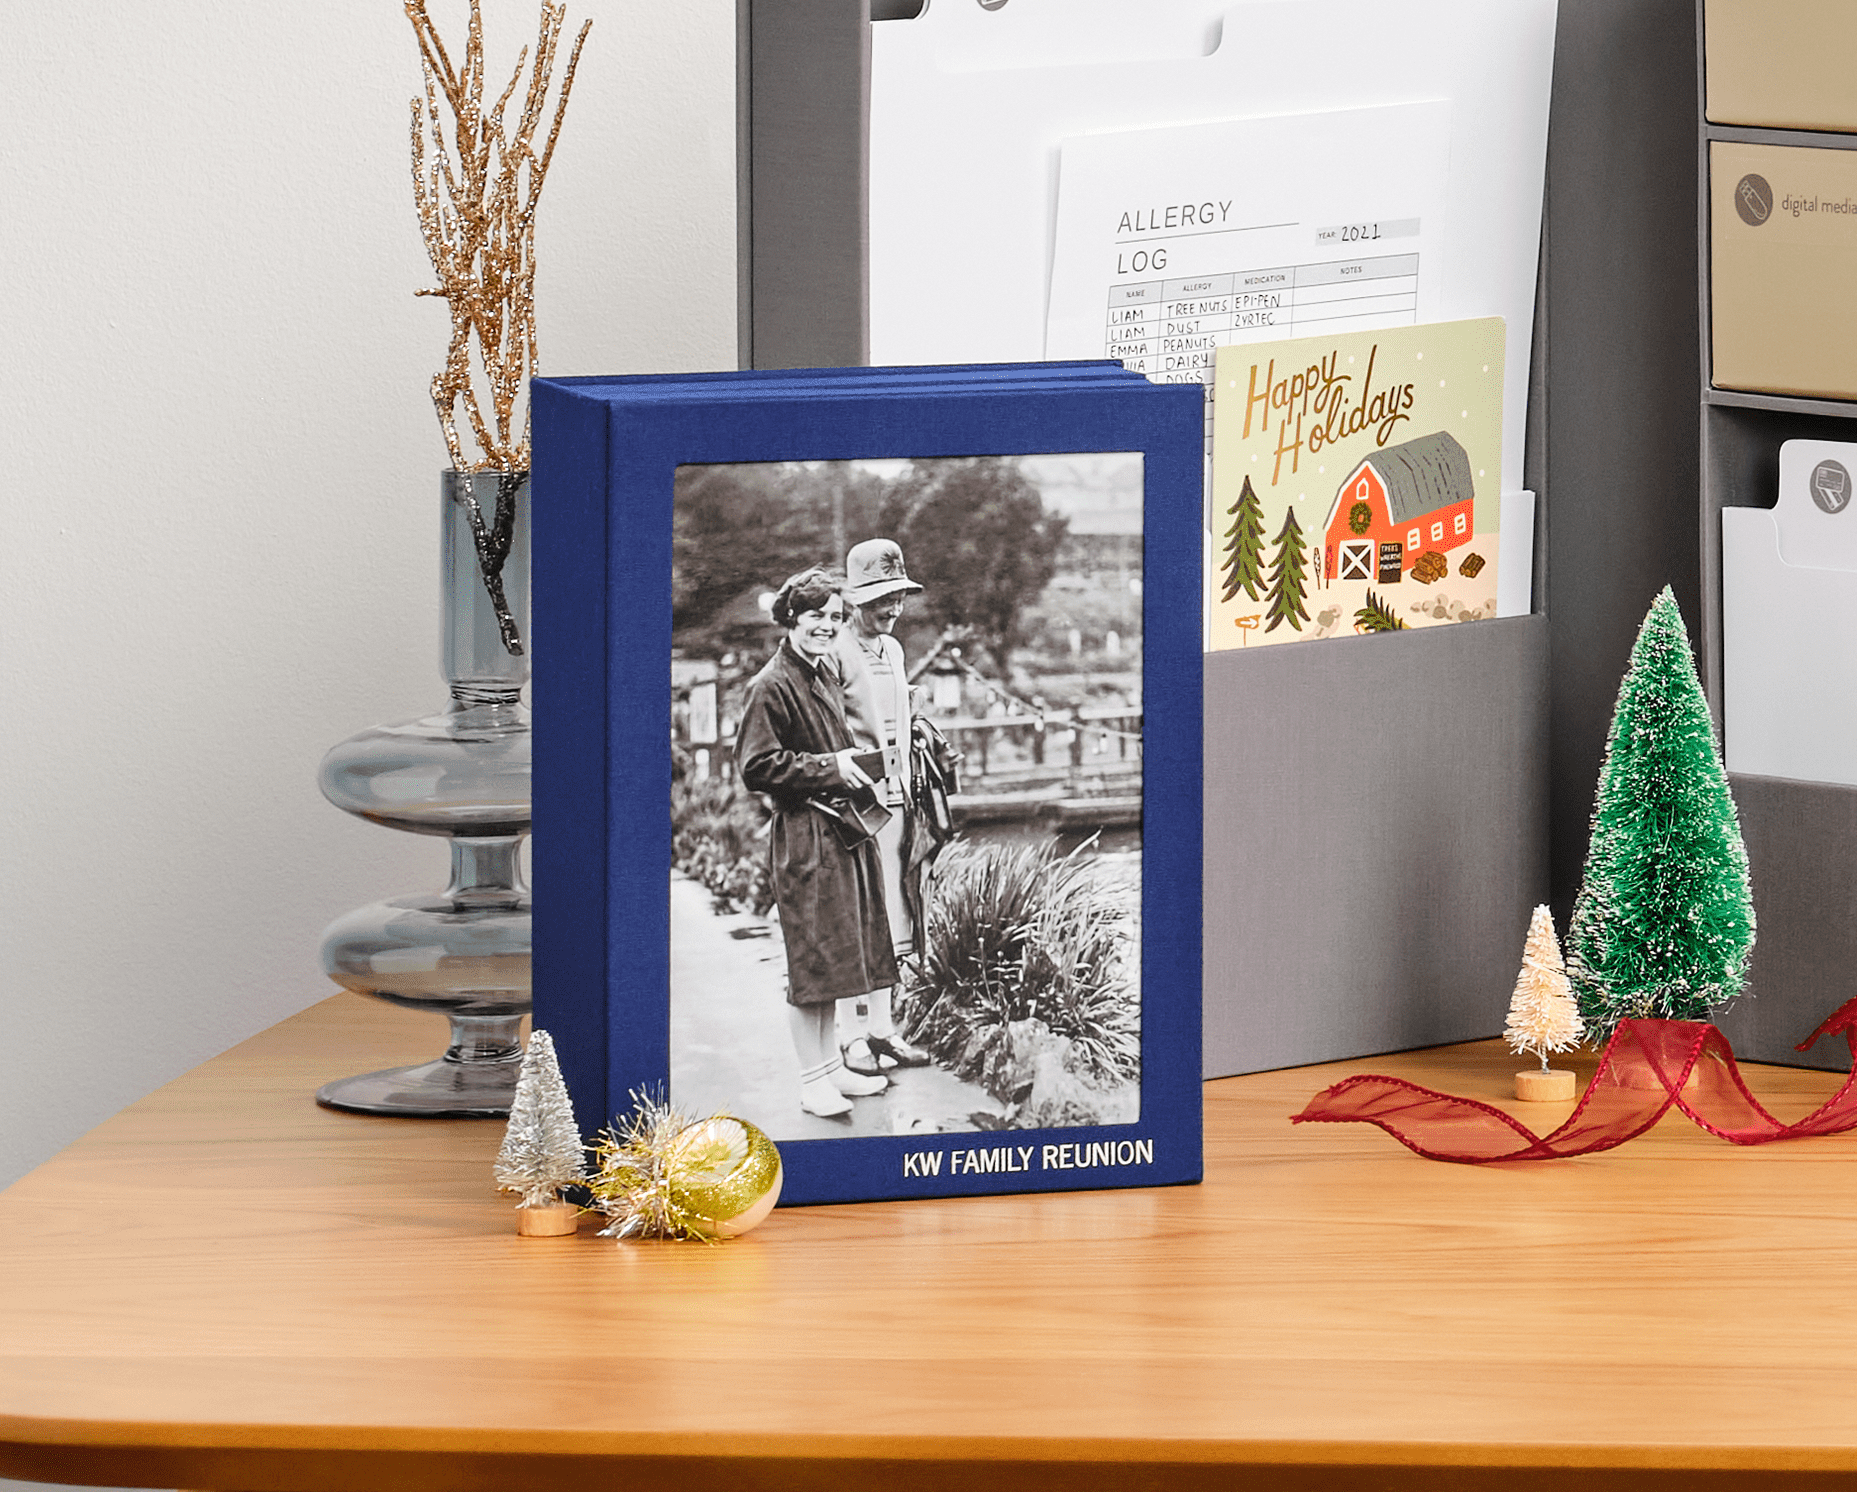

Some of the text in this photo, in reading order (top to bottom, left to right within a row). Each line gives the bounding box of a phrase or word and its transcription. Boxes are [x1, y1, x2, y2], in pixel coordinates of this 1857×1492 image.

[1781, 194, 1857, 218] digital media
[1117, 200, 1232, 234] ALLERGY
[1341, 223, 1381, 242] 2021
[1117, 248, 1167, 275] LOG
[1340, 265, 1362, 275] NOTES
[1183, 282, 1212, 292] ALLERGY
[1244, 274, 1286, 285] MEDICATION
[1126, 290, 1145, 298] NAME
[1235, 293, 1281, 309] EPI-PEN
[1111, 309, 1144, 324] LIAM
[1167, 299, 1228, 318] TREE NUTS
[1111, 326, 1146, 342] LIAM
[1167, 320, 1201, 337] DUST
[1110, 342, 1148, 359] EMMA
[1163, 334, 1216, 353] PEANUTS
[1165, 352, 1208, 371] DAIRY
[1242, 350, 1352, 440] Happy
[1272, 345, 1414, 486] Holidays
[903, 1138, 1154, 1178] KW FAMILY REUNION
